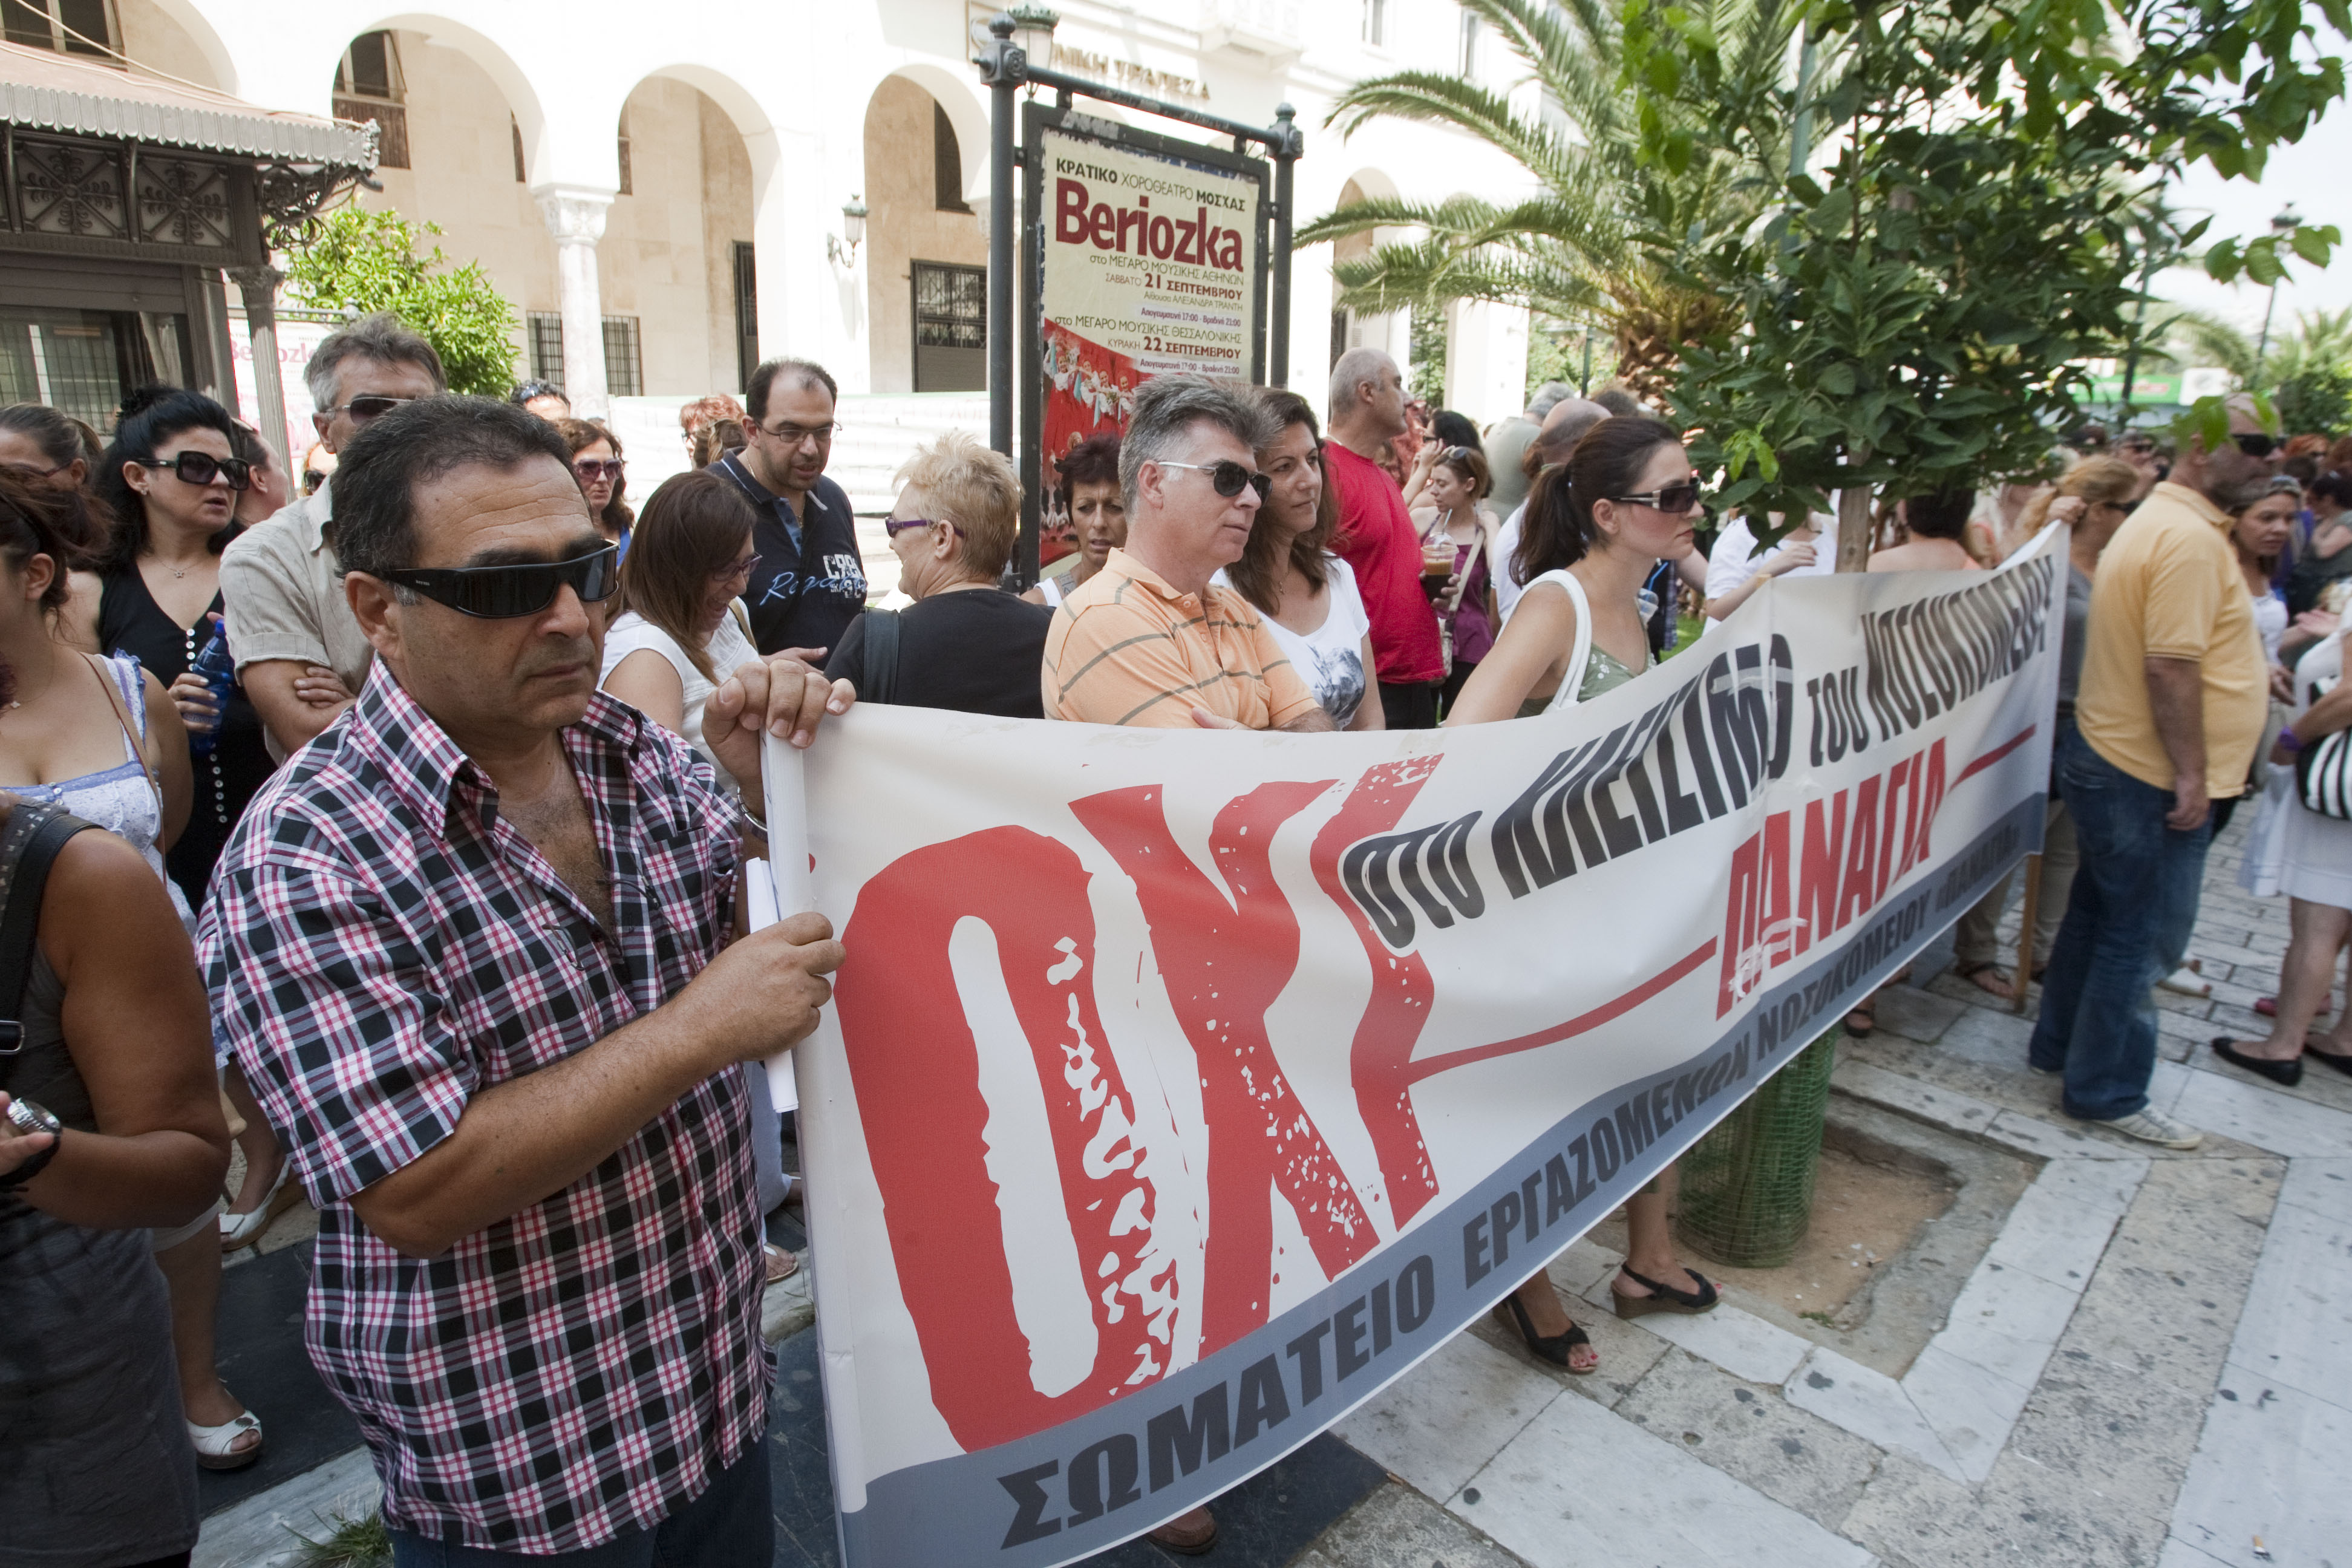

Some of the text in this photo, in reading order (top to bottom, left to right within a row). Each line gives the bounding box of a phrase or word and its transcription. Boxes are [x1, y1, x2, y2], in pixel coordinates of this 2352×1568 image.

[1056, 158, 1246, 212] ΚΡΑΤΙΚΟ ΧΟΡΟΘΕΑΤΡΟ ΜΟΣΧΑΣ
[1056, 177, 1244, 273] Beriozka
[1089, 255, 1244, 286] στο ΜΕΓΑΡΟ ΜΟΥΣΙΚΗΣ ΑΘΗΝΩΝ
[1105, 272, 1243, 300] ΣΑΒΒΑΤΟ 21 ΣΕΠΤΕΜΒΡΙΟΥ
[1054, 315, 1243, 344] στο ΜΕΓΑΡΟ ΜΟΥΣΙΚΗΣ ΘΕΣΣΑΛΟΝΙΚΗΣ
[1182, 312, 1198, 322] 17:00
[1226, 318, 1241, 327] 21:00
[1108, 336, 1241, 359] ΚΥΡΙΑΚΗ 22 ΣΕΠΤΕΜΒΡΙΟΥ
[1716, 736, 1946, 1021] ΠΑΝΑΓΙΑ
[997, 1255, 1436, 1551] ΣΩΜΑΤΕΙΟ
[1463, 1031, 1750, 1290] ΕΡΓΑΖΟΜΕΝΩΝ
[1757, 889, 1932, 1062] ΝΟΣΟΚΟΜΕΙΟΥ
